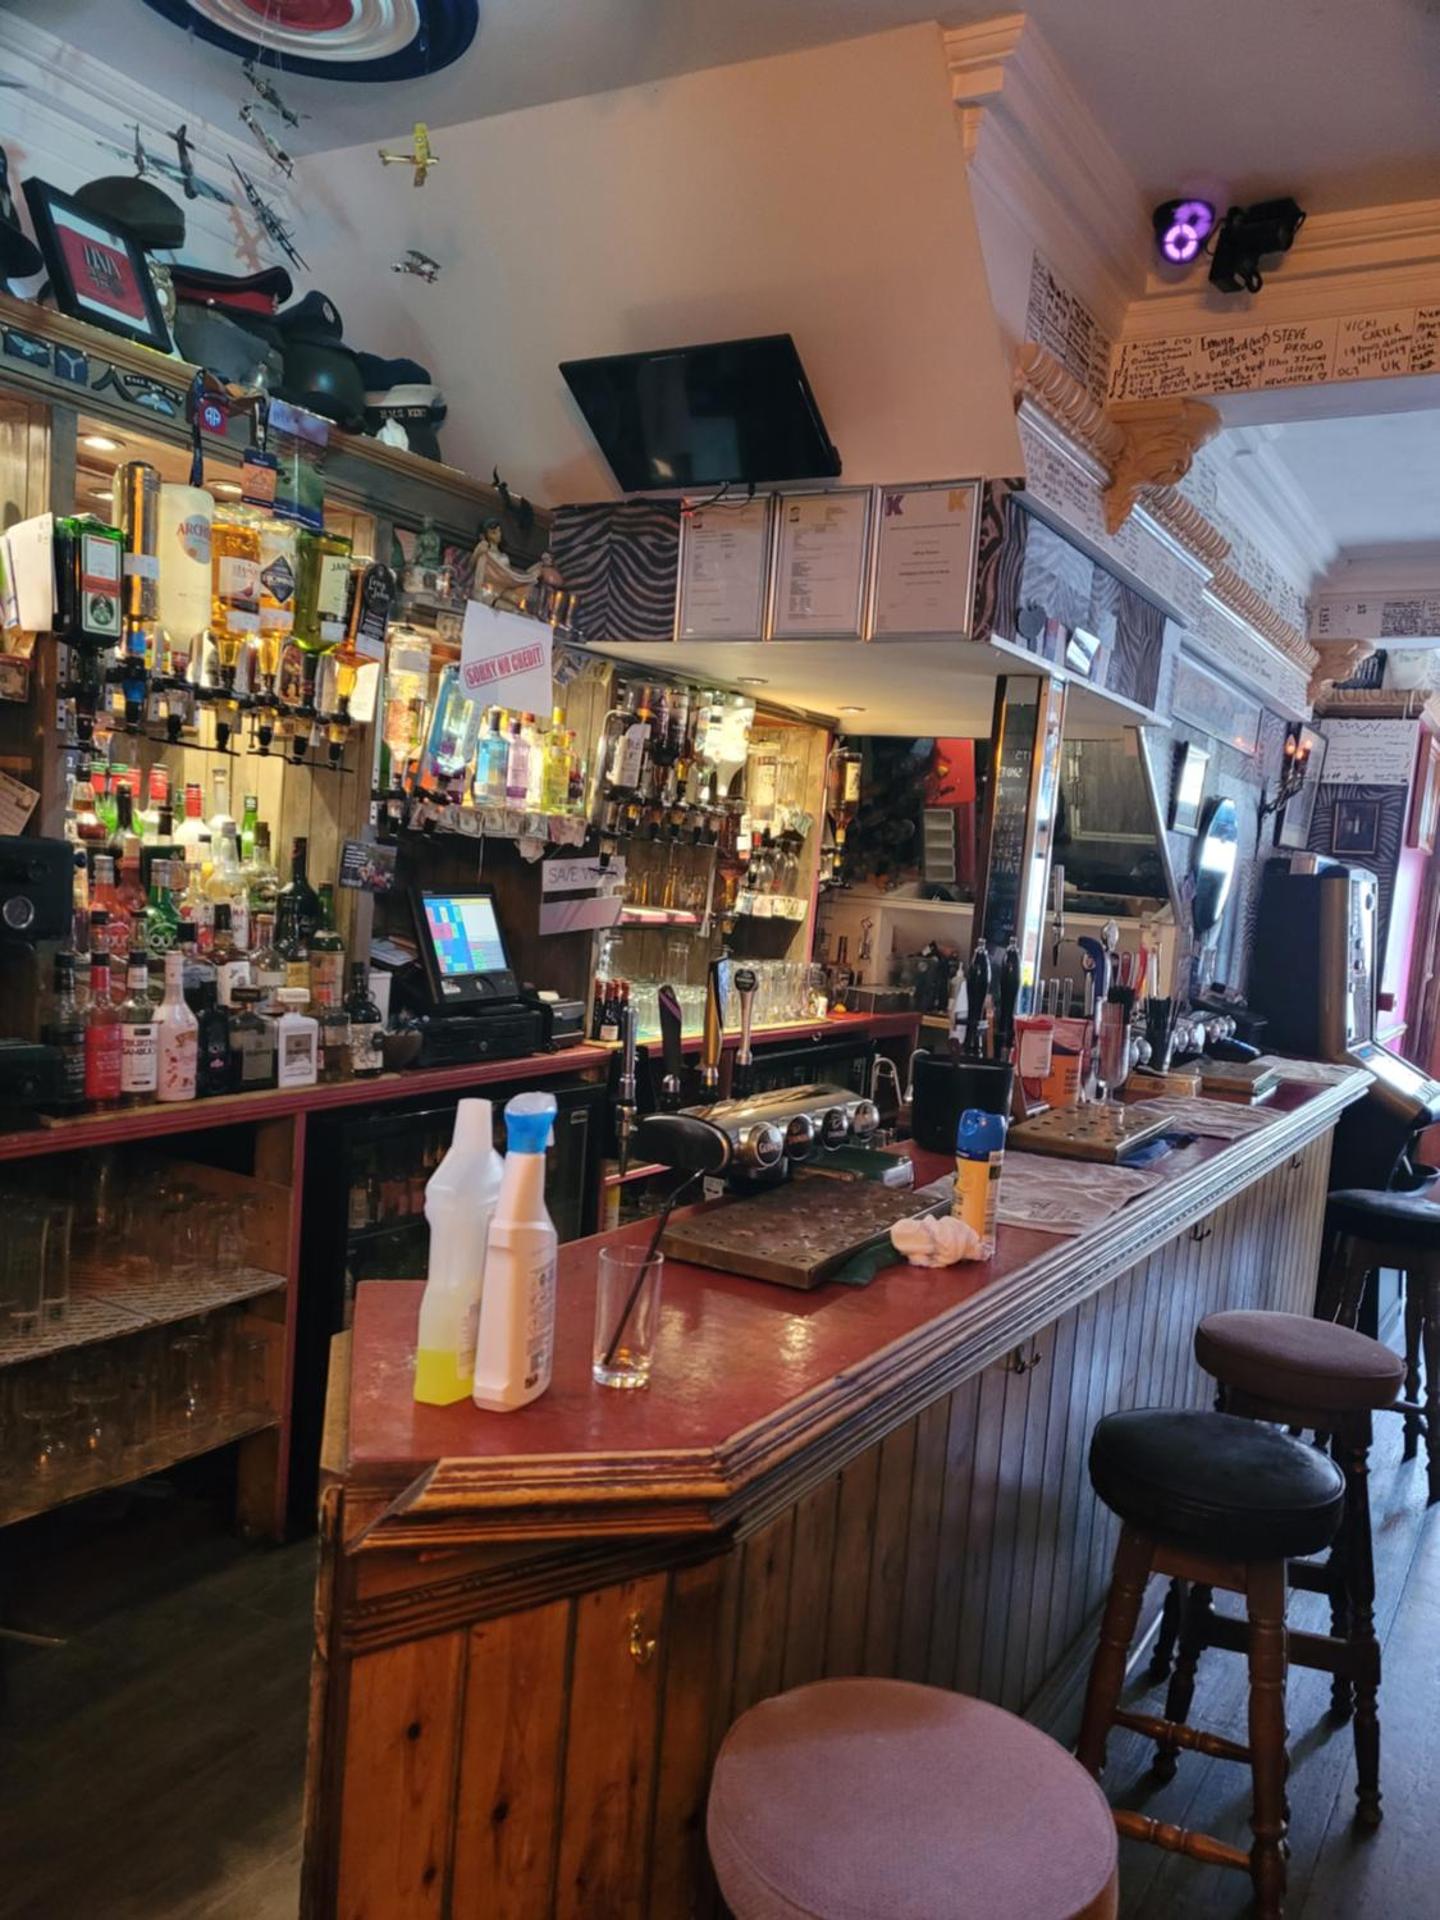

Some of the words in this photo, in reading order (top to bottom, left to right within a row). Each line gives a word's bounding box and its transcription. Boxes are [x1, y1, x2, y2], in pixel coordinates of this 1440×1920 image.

[1272, 327, 1307, 344] STEVE
[1283, 339, 1324, 354] PROUD
[1380, 360, 1402, 373] UK
[466, 660, 498, 685] SORRY
[497, 655, 512, 676] NO
[511, 646, 541, 671] CREDIT
[548, 866, 579, 884] SAVE
